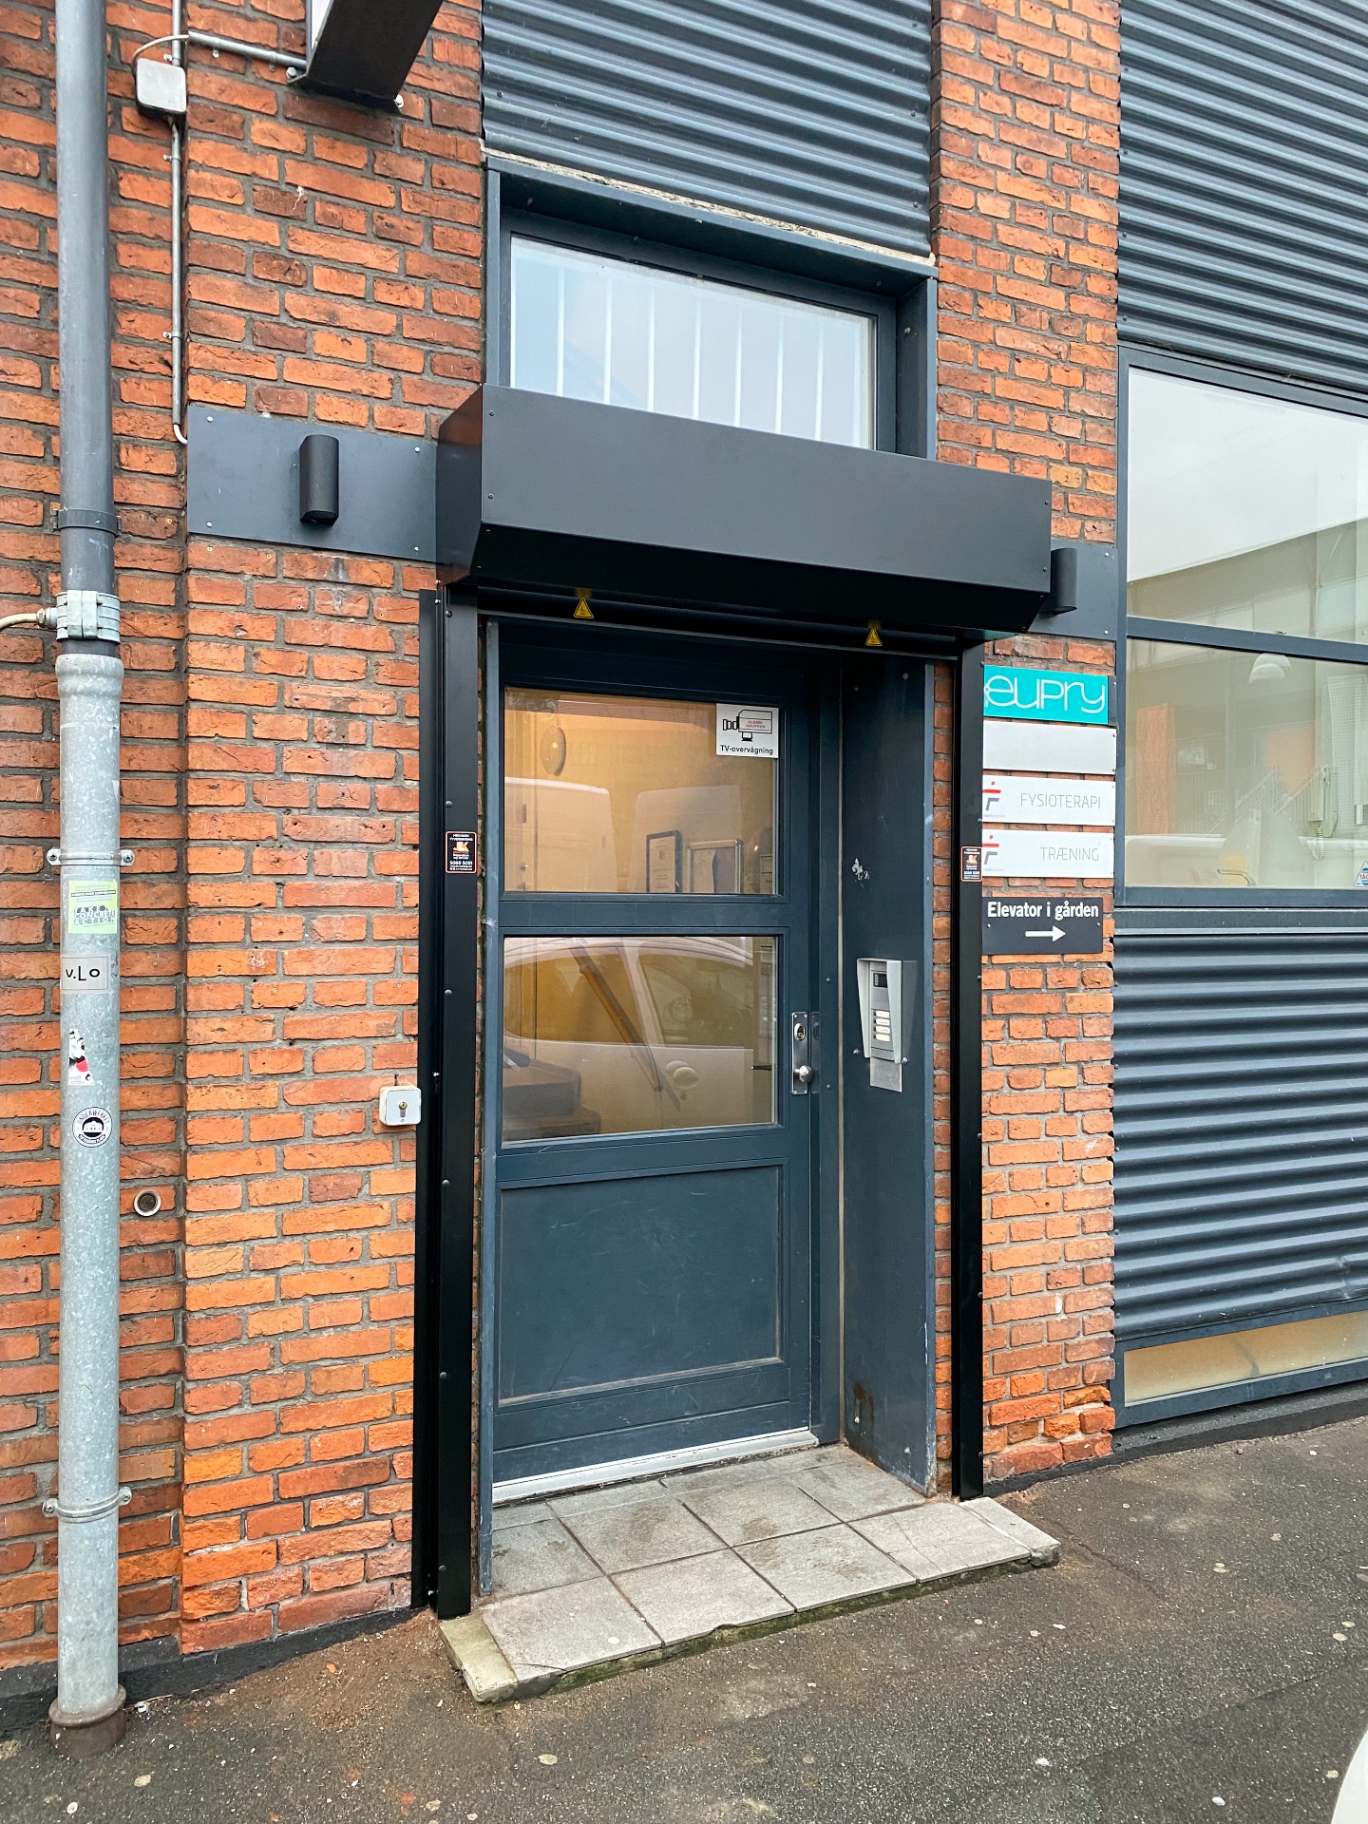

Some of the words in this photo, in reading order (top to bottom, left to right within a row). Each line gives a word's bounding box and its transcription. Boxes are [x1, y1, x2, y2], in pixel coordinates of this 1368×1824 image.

[984, 675, 1105, 714] eupry
[720, 744, 774, 755] TV-overvågning
[1020, 793, 1101, 809] FYSIOTERAPI
[1040, 846, 1100, 862] TRÆNING
[987, 901, 1043, 918] Elevator
[1046, 901, 1051, 918] i
[1054, 900, 1099, 921] gården
